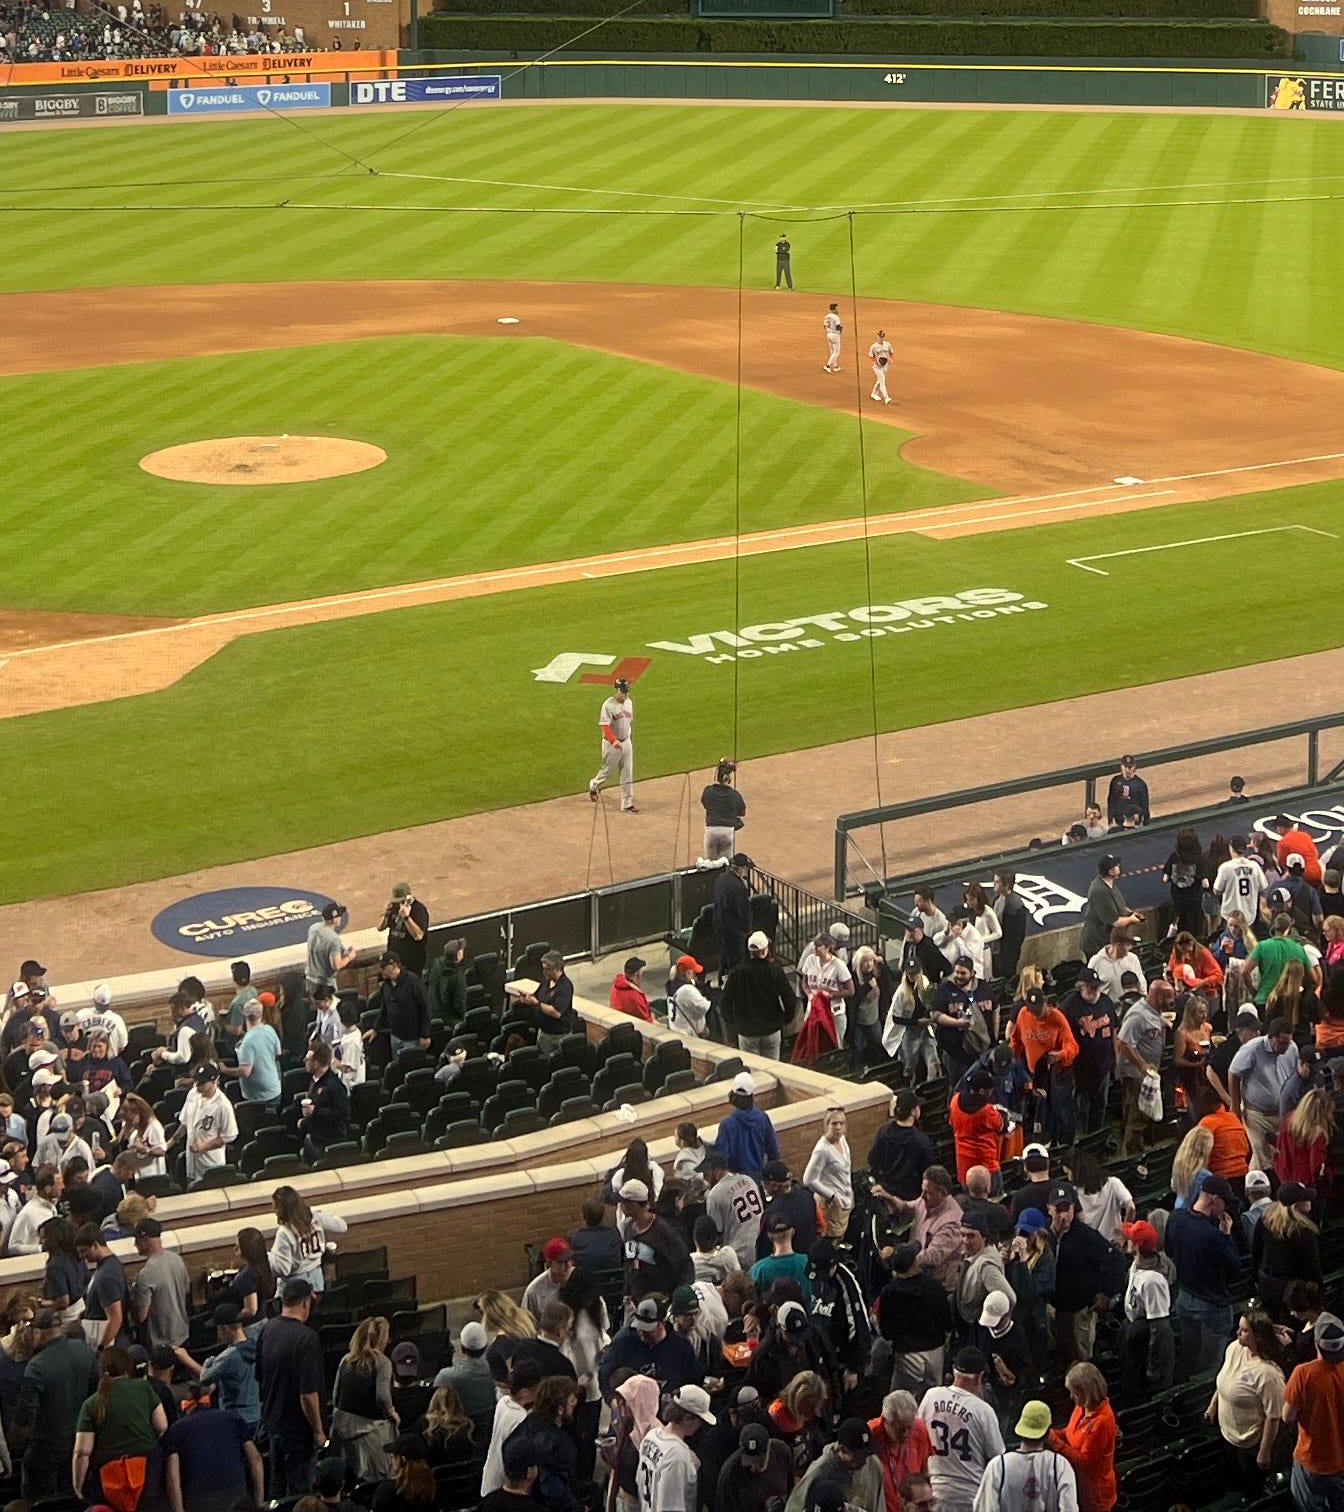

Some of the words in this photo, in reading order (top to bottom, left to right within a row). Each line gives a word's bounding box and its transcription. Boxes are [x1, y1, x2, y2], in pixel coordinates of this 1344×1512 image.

[343, 2, 350, 16] 1
[328, 20, 366, 29] WHITAKER
[61, 67, 84, 78] Little
[203, 61, 226, 72] Little
[196, 94, 244, 106] FANDUEL
[273, 90, 320, 102] FANDUEL
[357, 81, 407, 104] DTE
[34, 98, 81, 112] BIGGBY
[1310, 98, 1335, 109] STATE
[645, 587, 1025, 656] VICTORS
[705, 638, 825, 666] HOME
[833, 600, 1048, 642] SOLUTIONS
[1239, 878, 1249, 897] 8
[733, 1189, 762, 1224] 29
[934, 1400, 974, 1424] ROGERS
[930, 1419, 973, 1462] 34
